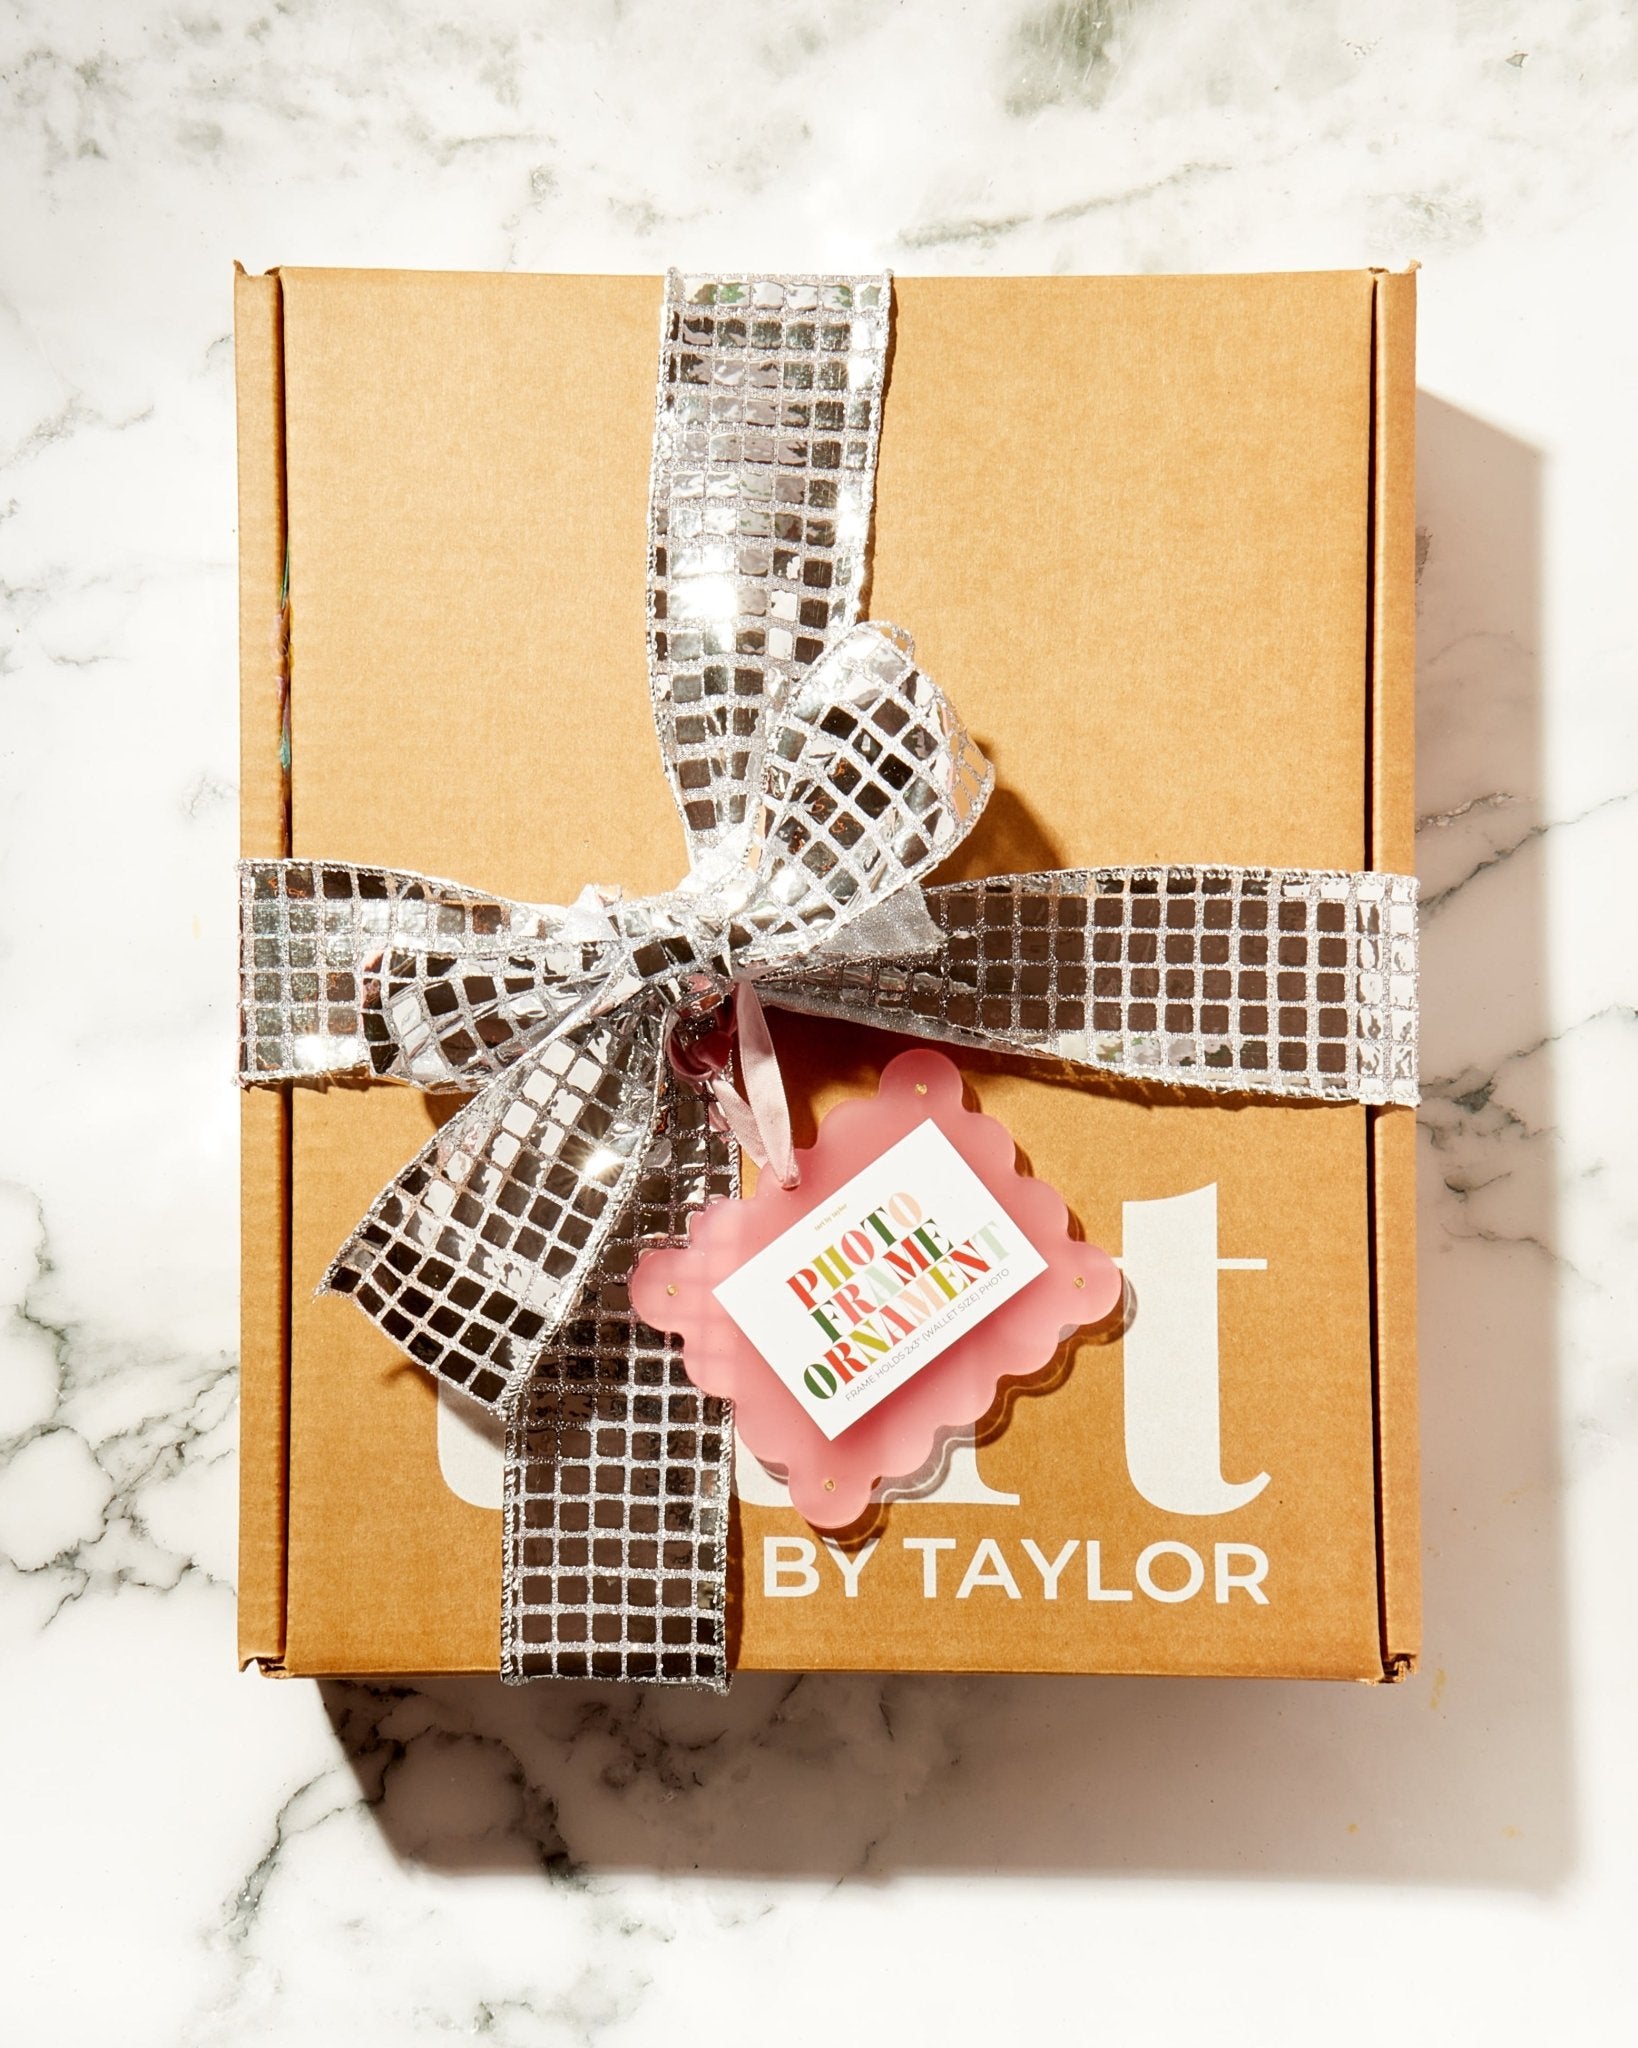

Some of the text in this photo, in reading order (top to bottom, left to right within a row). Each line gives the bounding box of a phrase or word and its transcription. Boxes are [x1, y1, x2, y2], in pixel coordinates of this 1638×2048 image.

[786, 1192, 922, 1310] PHOTO
[804, 1220, 1010, 1400] ORNAMENT
[811, 1219, 954, 1344] FRAME
[845, 1375, 876, 1401] FRAME
[875, 1351, 906, 1378] HOLDS
[922, 1309, 959, 1343] (WALLET
[957, 1292, 981, 1313] SIZE)
[979, 1268, 1010, 1297] PHOTO
[762, 1536, 1270, 1605] BY TAYLOR
